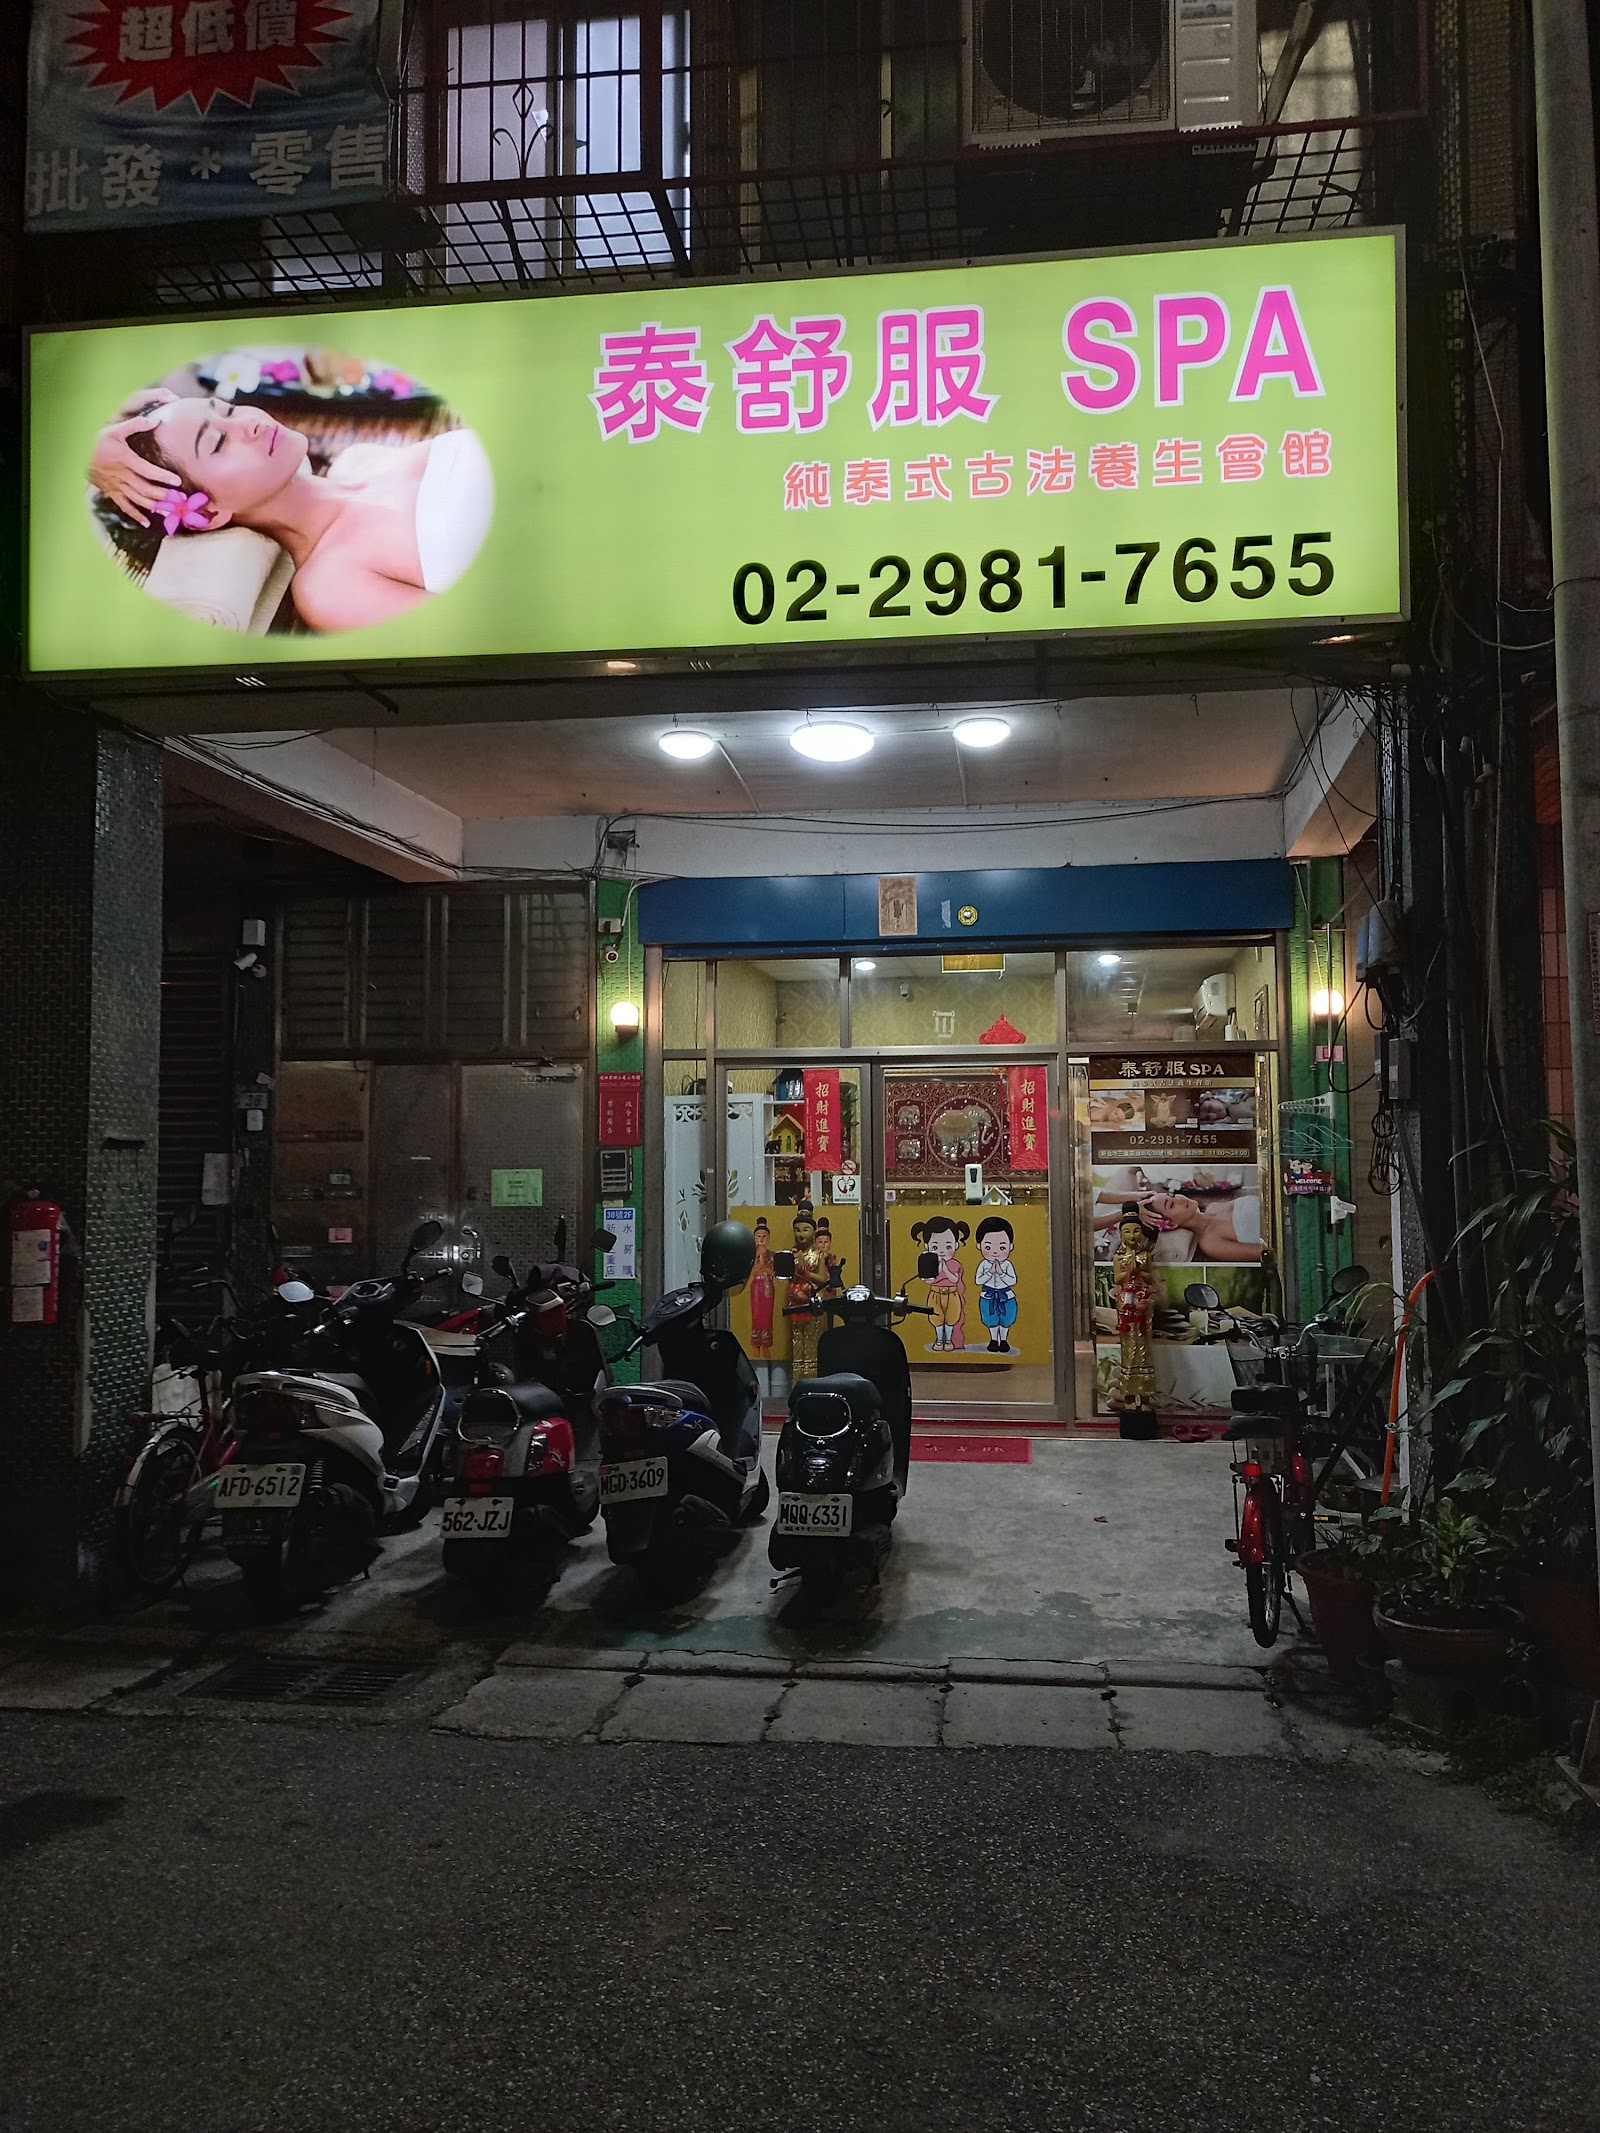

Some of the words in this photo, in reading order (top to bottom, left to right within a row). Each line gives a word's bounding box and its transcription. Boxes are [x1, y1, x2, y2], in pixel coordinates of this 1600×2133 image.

[117, 0, 298, 63] 超低價
[28, 143, 163, 216] 批發
[250, 124, 388, 195] 零售
[588, 305, 1000, 444] 泰舒服
[1061, 285, 1327, 414] SPA
[784, 428, 1333, 511] 純泰式古法養生會館
[732, 532, 1335, 625] 02-2981-7655
[815, 1082, 830, 1152] 招財進寶
[1020, 1079, 1037, 1151] 招財進寶
[1129, 1134, 1218, 1145] 02-2981-7655
